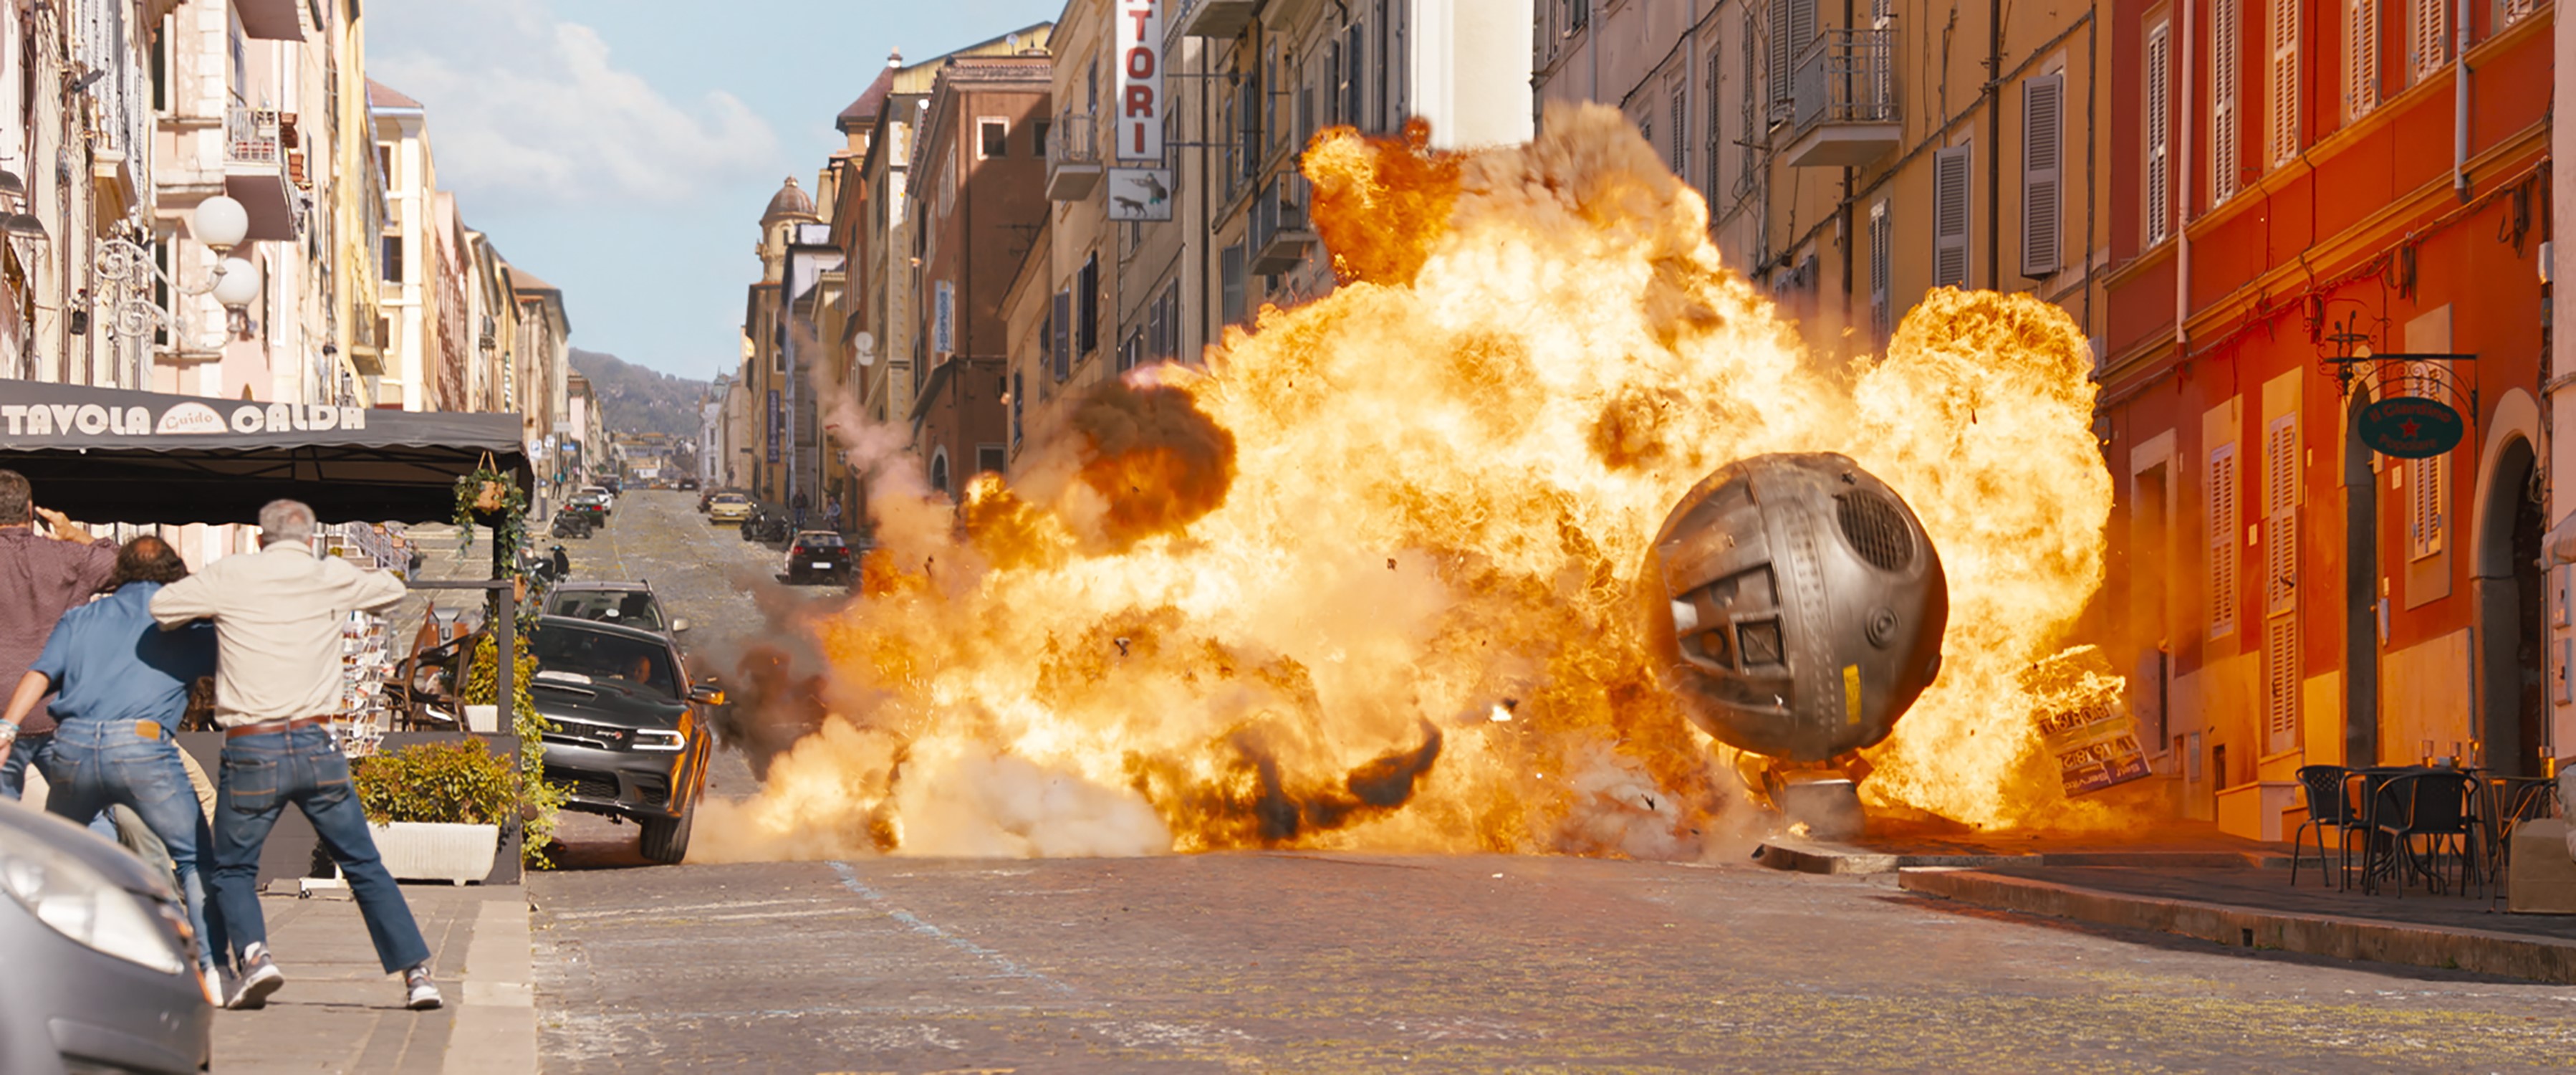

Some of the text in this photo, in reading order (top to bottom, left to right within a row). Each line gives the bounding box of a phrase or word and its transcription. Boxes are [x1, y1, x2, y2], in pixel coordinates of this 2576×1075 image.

[1126, 0, 1155, 153] TORI
[1, 403, 365, 435] TAVOLA CALDA
[165, 411, 213, 430] Guido
[2382, 402, 2451, 424] Giardino
